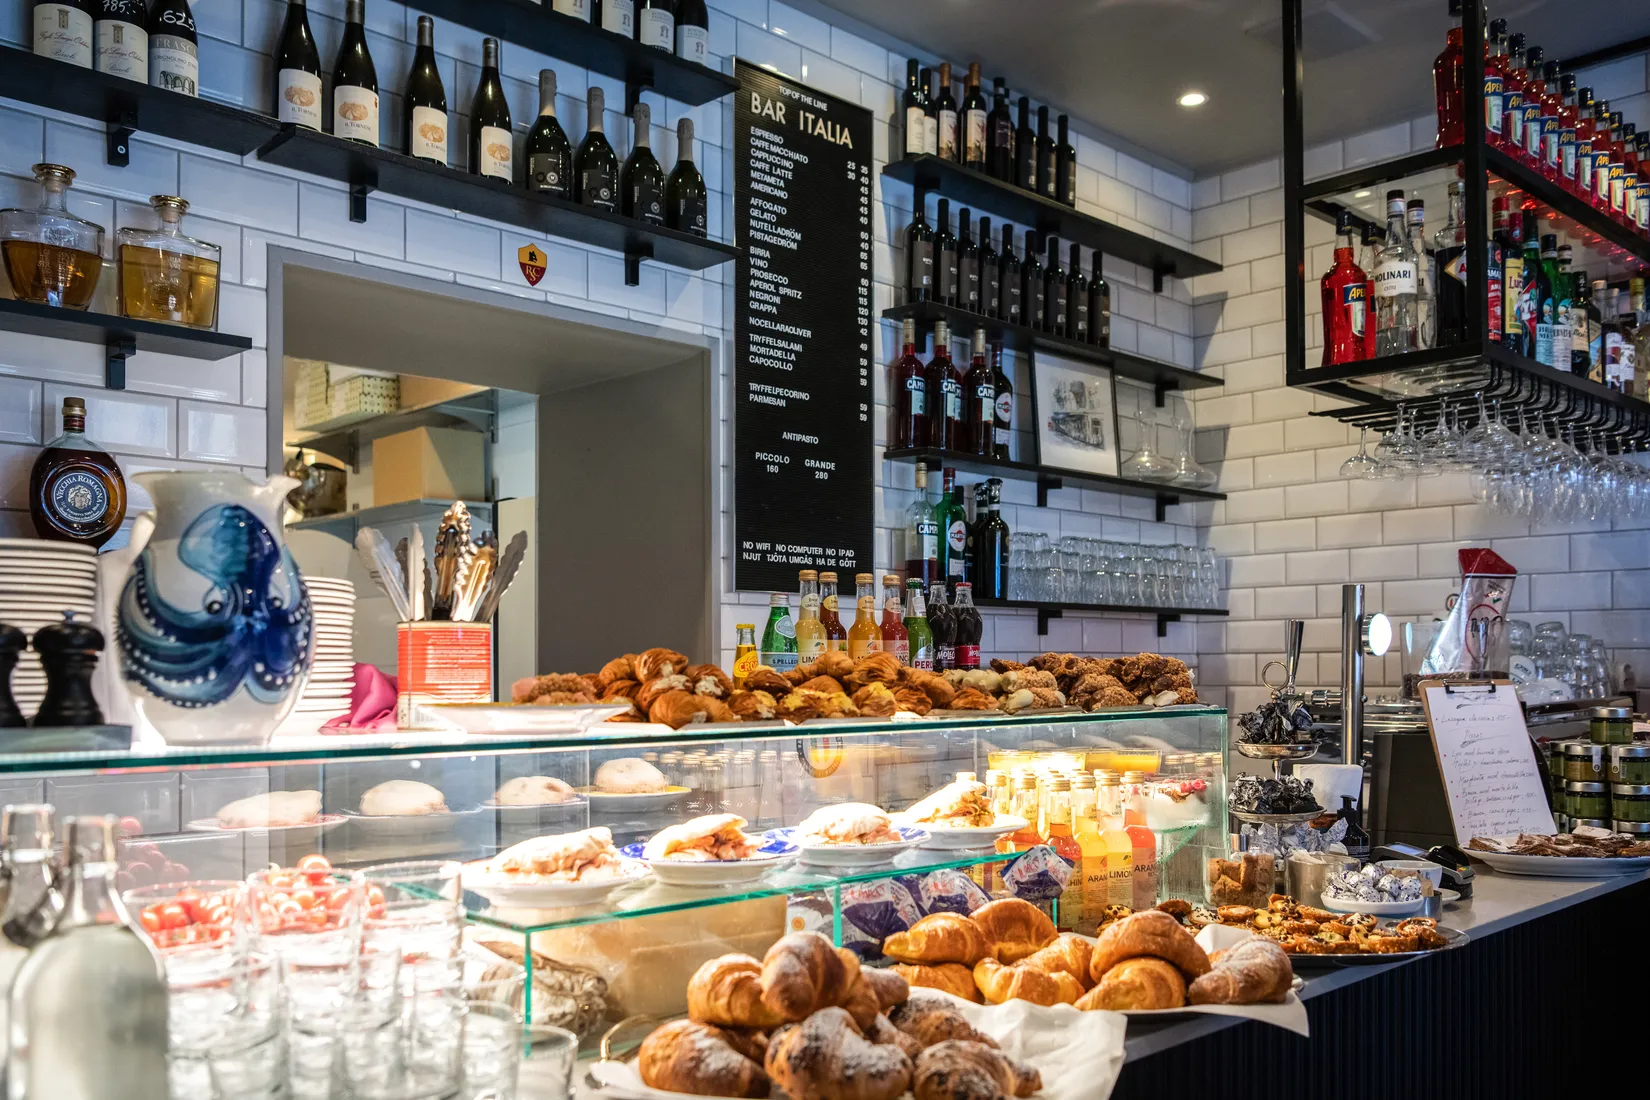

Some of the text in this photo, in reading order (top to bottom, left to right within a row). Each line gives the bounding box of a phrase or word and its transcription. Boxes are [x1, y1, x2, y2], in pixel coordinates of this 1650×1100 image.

[779, 86, 828, 111] TOP OF THE LINE
[751, 92, 853, 149] BAR ITALIA
[750, 126, 784, 144] ESPRESSO
[750, 137, 770, 150] CAFFE
[770, 144, 809, 164] MACCHIATO
[750, 148, 794, 169] CAPPUCCINO
[750, 159, 770, 172] CAFFE
[772, 166, 793, 180] LATTE
[750, 181, 788, 199] AMERICANO
[750, 197, 787, 215] AFFOGATO
[750, 207, 777, 222] GELATO
[750, 218, 801, 241] NUTELLADRÖM
[750, 229, 797, 250] PISTAGEDRÖM
[750, 246, 770, 258] BIRRA
[750, 257, 768, 268] VINO
[750, 268, 789, 285] PROSECCO
[749, 289, 780, 304] NEGRONI
[750, 279, 777, 292] APEROL
[779, 287, 802, 299] SPRITZ
[749, 301, 777, 315] GRAPPA
[749, 316, 812, 338] NOCELLARAOLIVER
[749, 333, 802, 352] TRYFFELSALAMI
[750, 344, 796, 361] MORTADELLA
[749, 355, 793, 371] CAPOCOLLO
[749, 382, 810, 400] TRYFFELPECORINO
[749, 394, 786, 407] PARMESAN
[782, 431, 819, 445] ANTIPASTO
[755, 452, 836, 470] PICCOLO GRANDE
[767, 465, 828, 480] 160 280
[56, 475, 103, 503] VECCHIA ROMAGNA
[743, 541, 854, 557] NO WIFI NO COMPUTER NO IPAD
[743, 552, 856, 568] NJUT TJÖTA UMGÅS HA DE GÖTT
